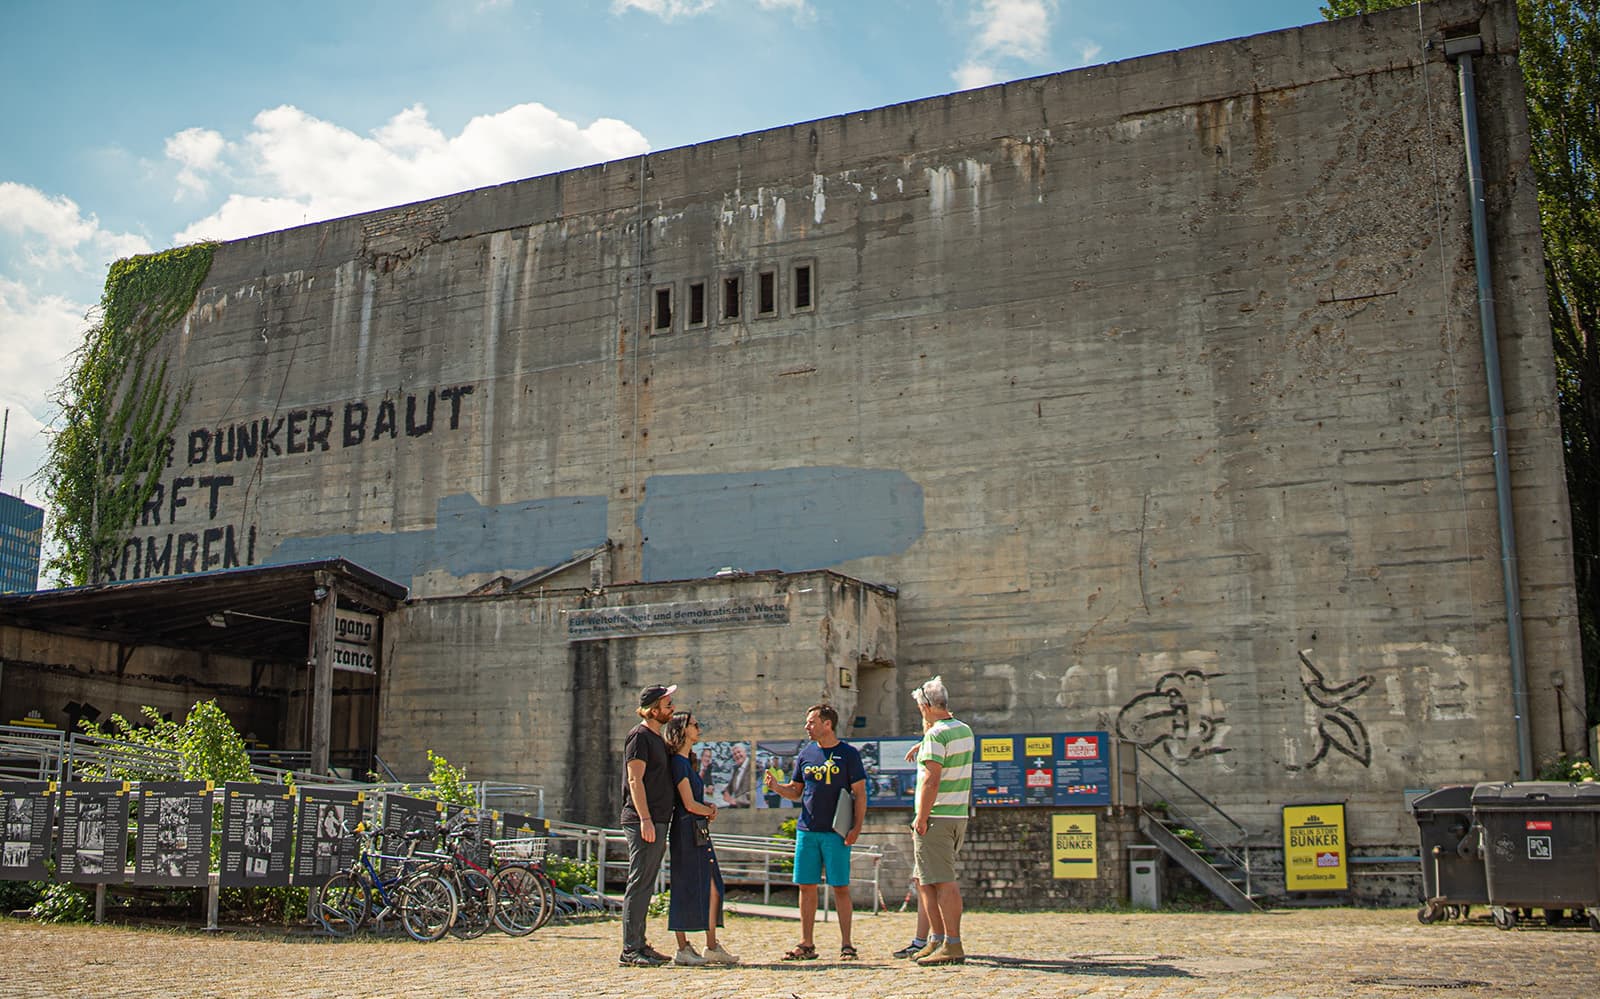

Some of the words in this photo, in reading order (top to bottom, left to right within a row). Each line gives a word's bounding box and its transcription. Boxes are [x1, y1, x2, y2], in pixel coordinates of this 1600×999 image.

[188, 407, 334, 466] BUNKER
[342, 384, 474, 448] BAUT
[587, 613, 651, 625] Weltoffeheit
[653, 609, 671, 619] und
[674, 606, 751, 618] demokratische
[753, 603, 785, 612] Werte
[335, 618, 372, 640] gang
[984, 745, 1011, 753] HITLER
[1056, 840, 1093, 849] BUNKER
[1291, 835, 1339, 847] BUNKER
